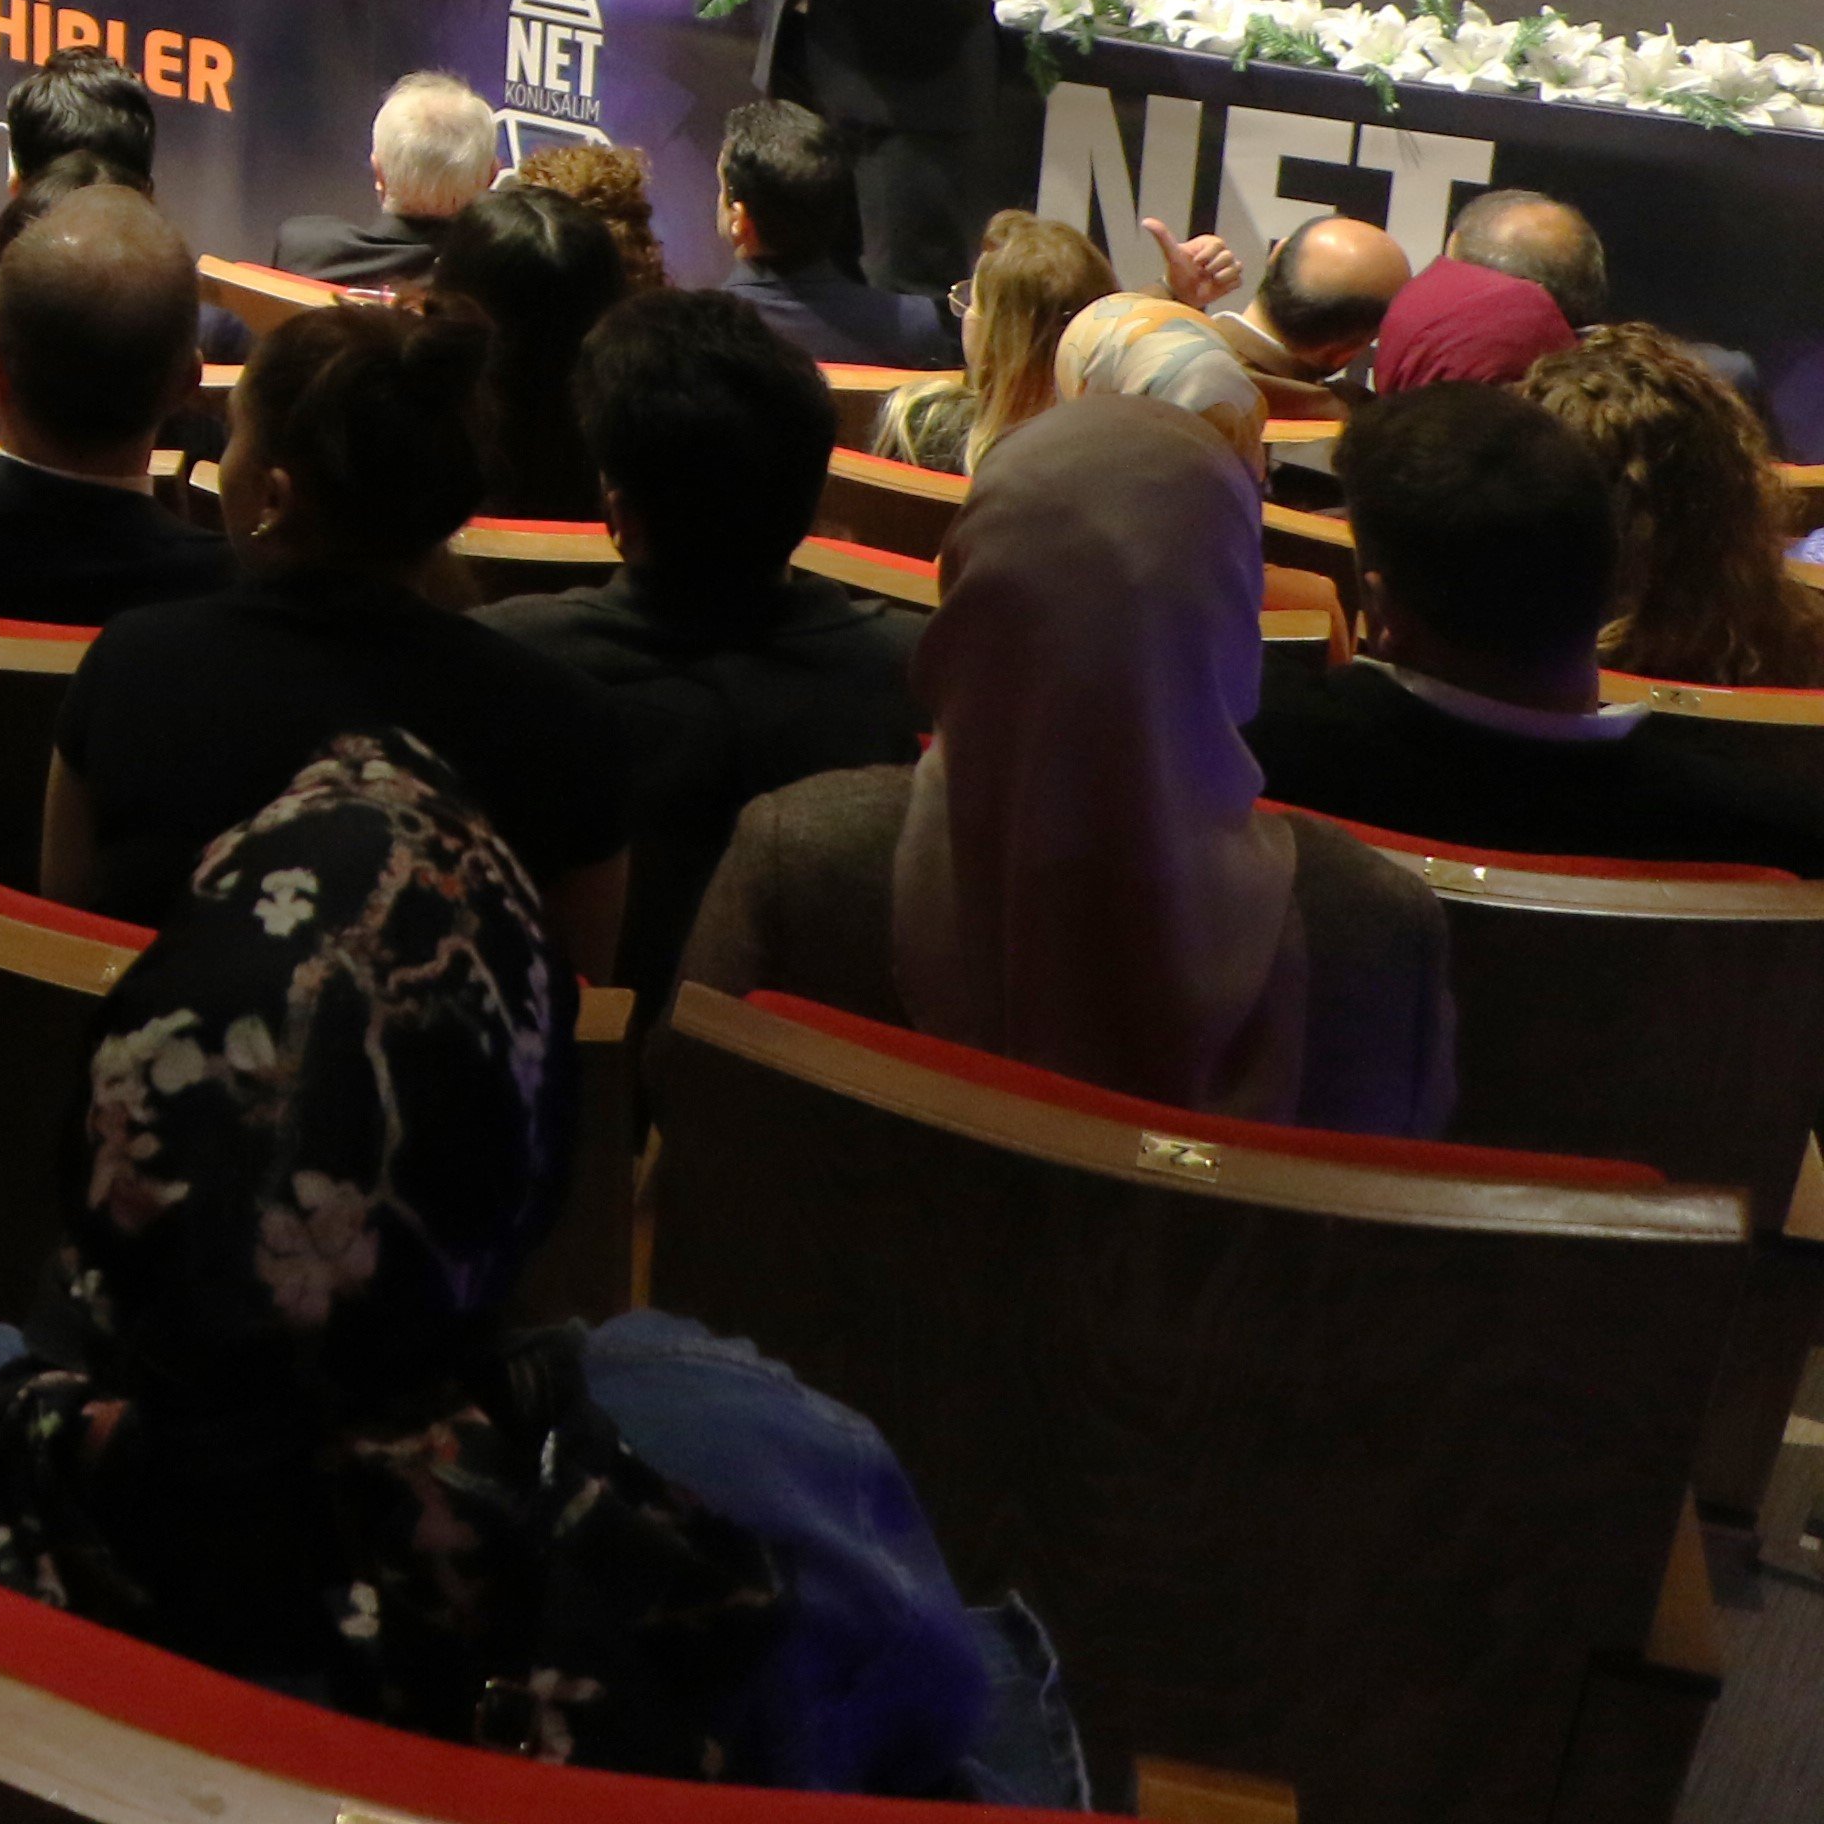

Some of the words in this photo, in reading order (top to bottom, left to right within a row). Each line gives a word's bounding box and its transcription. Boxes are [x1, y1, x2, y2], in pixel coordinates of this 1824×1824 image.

[505, 16, 604, 98] NET
[505, 81, 600, 123] KONUŞALIM
[1036, 80, 1496, 312] NET
